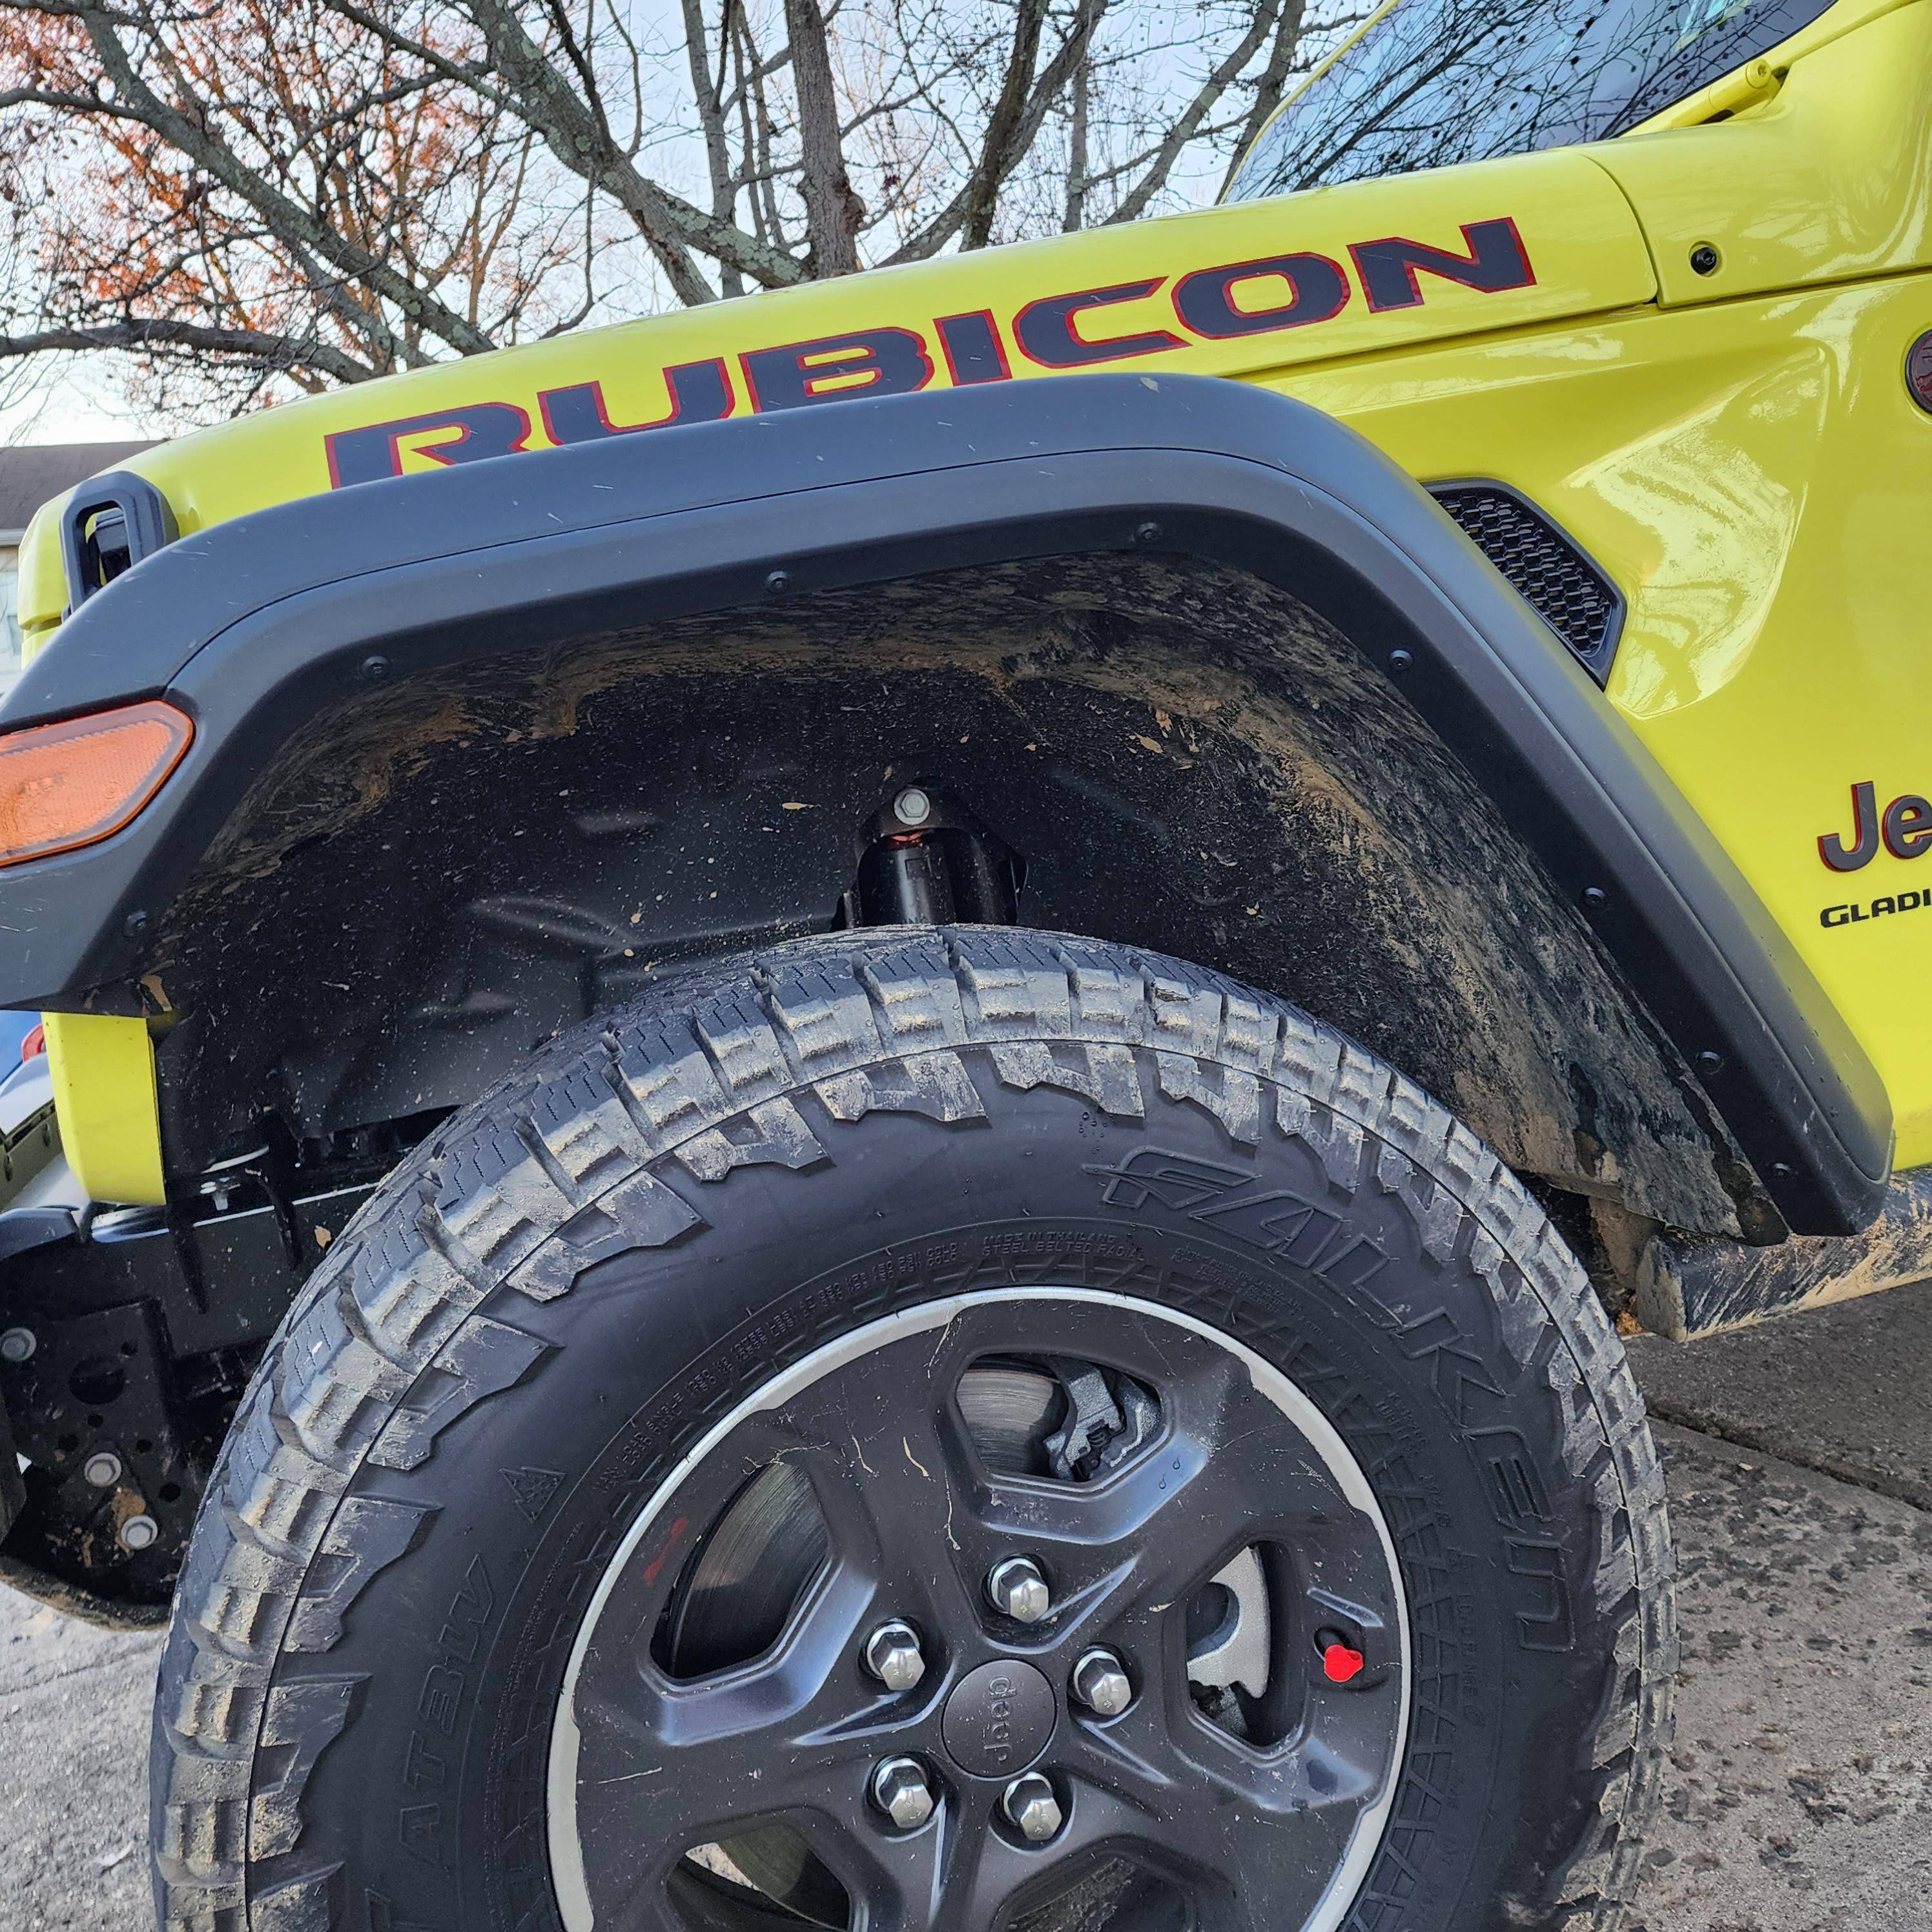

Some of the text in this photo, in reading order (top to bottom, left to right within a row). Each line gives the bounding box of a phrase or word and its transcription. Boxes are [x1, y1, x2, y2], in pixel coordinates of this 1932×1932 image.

[324, 216, 1537, 489] RUBICON
[1082, 1146, 1577, 1653] FALKEN
[983, 1676, 1017, 1762] Jeep
